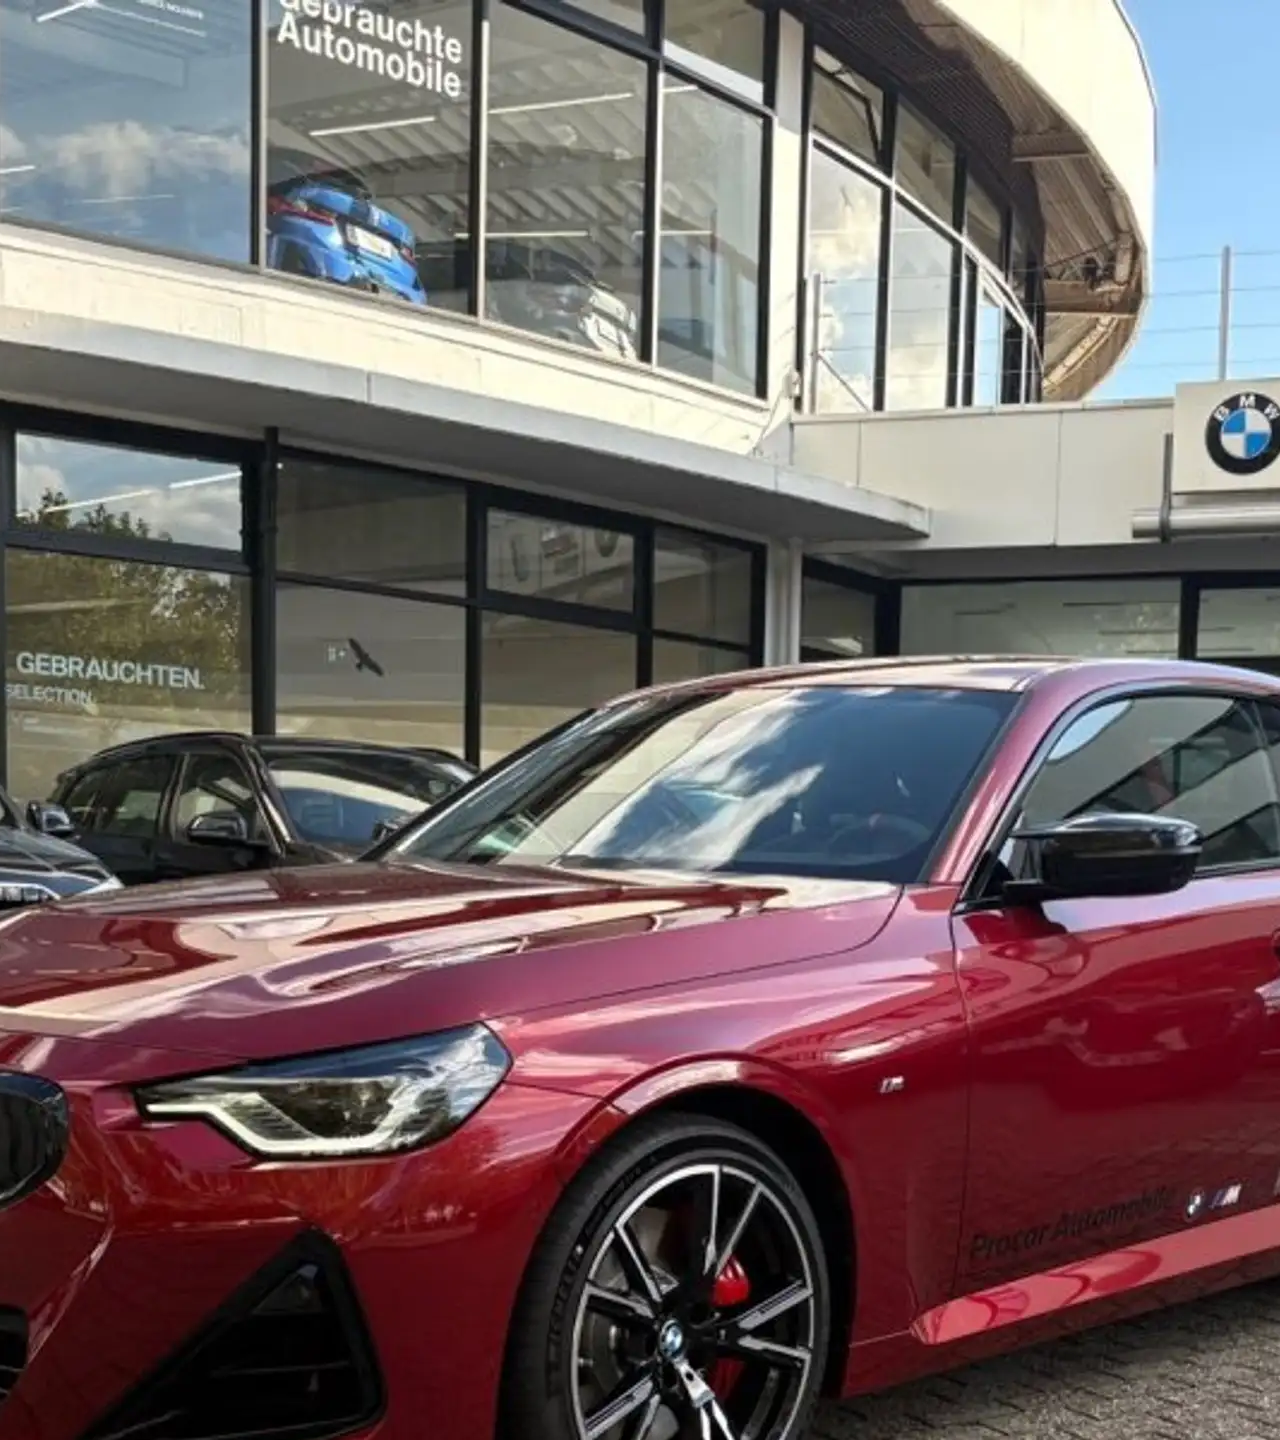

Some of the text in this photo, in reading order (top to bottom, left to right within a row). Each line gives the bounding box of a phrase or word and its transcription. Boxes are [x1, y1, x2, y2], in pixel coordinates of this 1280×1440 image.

[277, 11, 461, 98] Automobile
[16, 651, 205, 690] GEBRAUCHTEN.
[973, 1222, 1049, 1261] Procar
